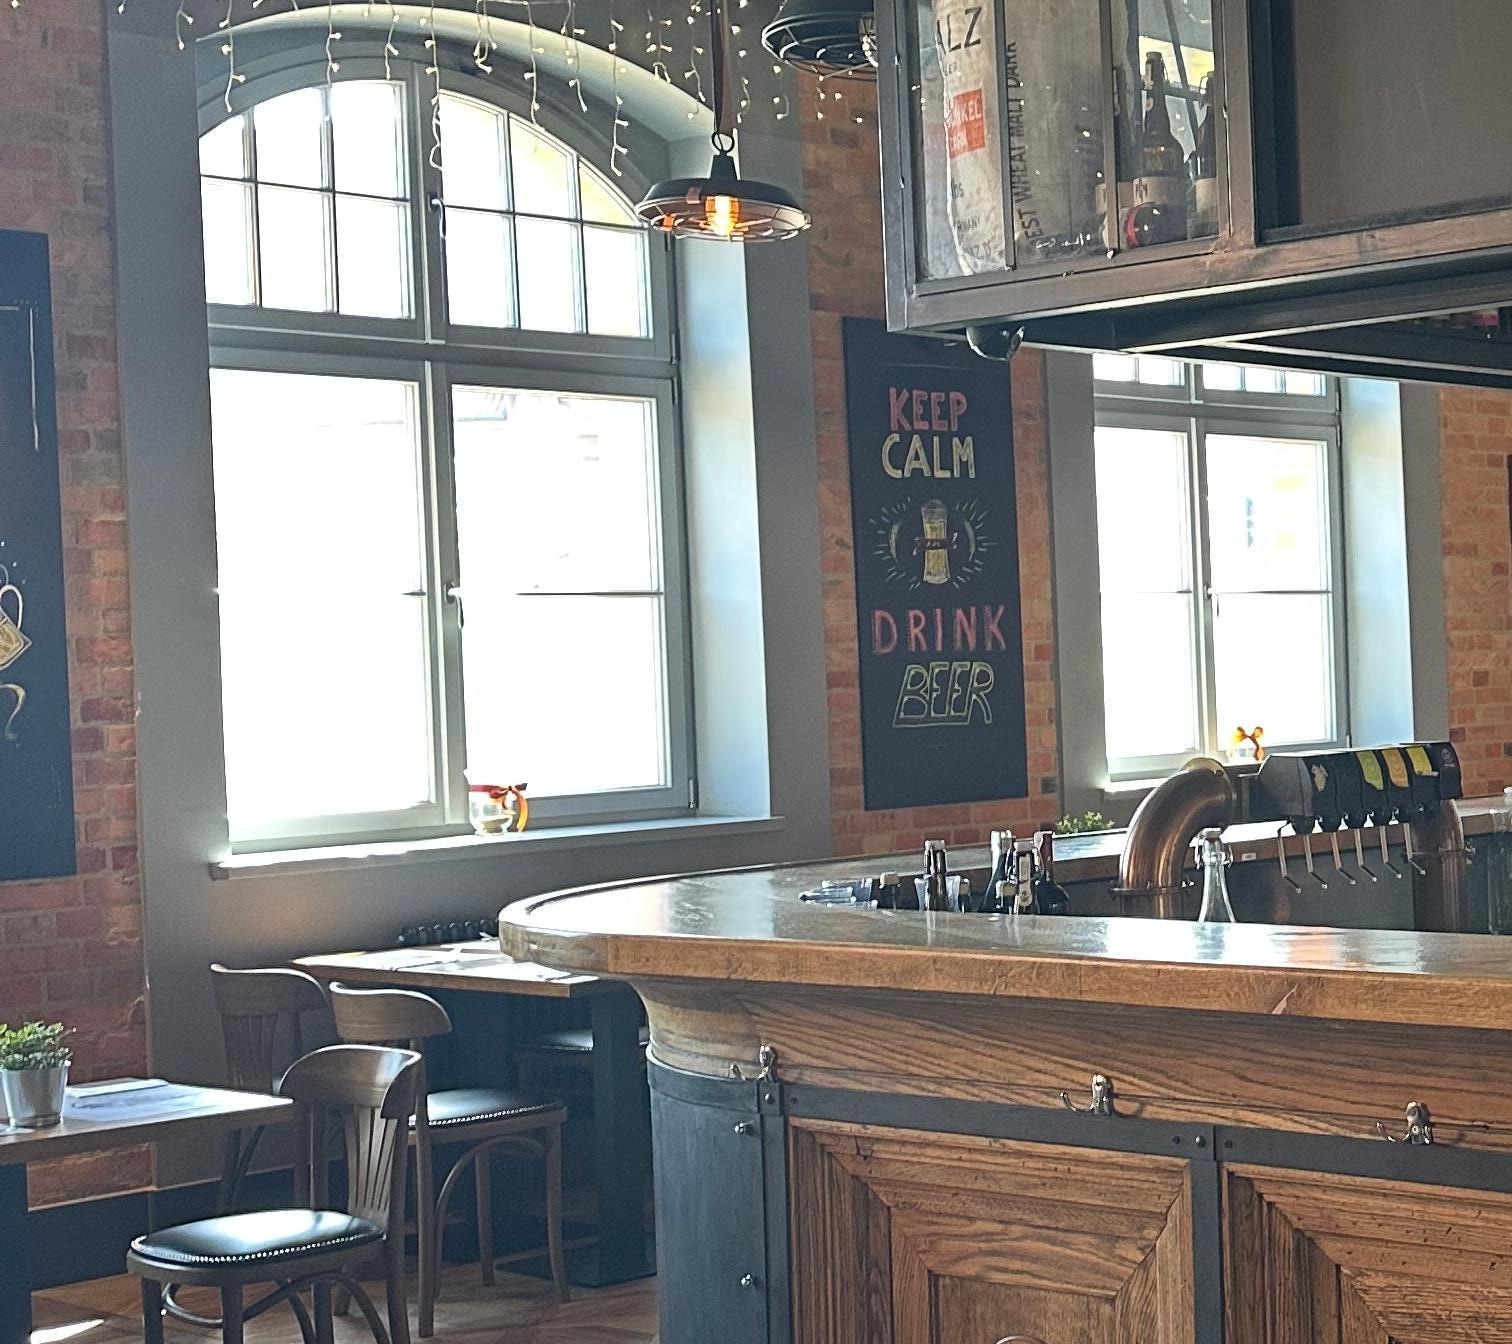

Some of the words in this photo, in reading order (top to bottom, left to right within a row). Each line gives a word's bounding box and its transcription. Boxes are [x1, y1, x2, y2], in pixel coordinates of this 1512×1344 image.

[888, 386, 968, 433] KEEP
[881, 434, 976, 480] CALM
[871, 604, 1007, 656] DRINK
[893, 661, 994, 728] BEER
